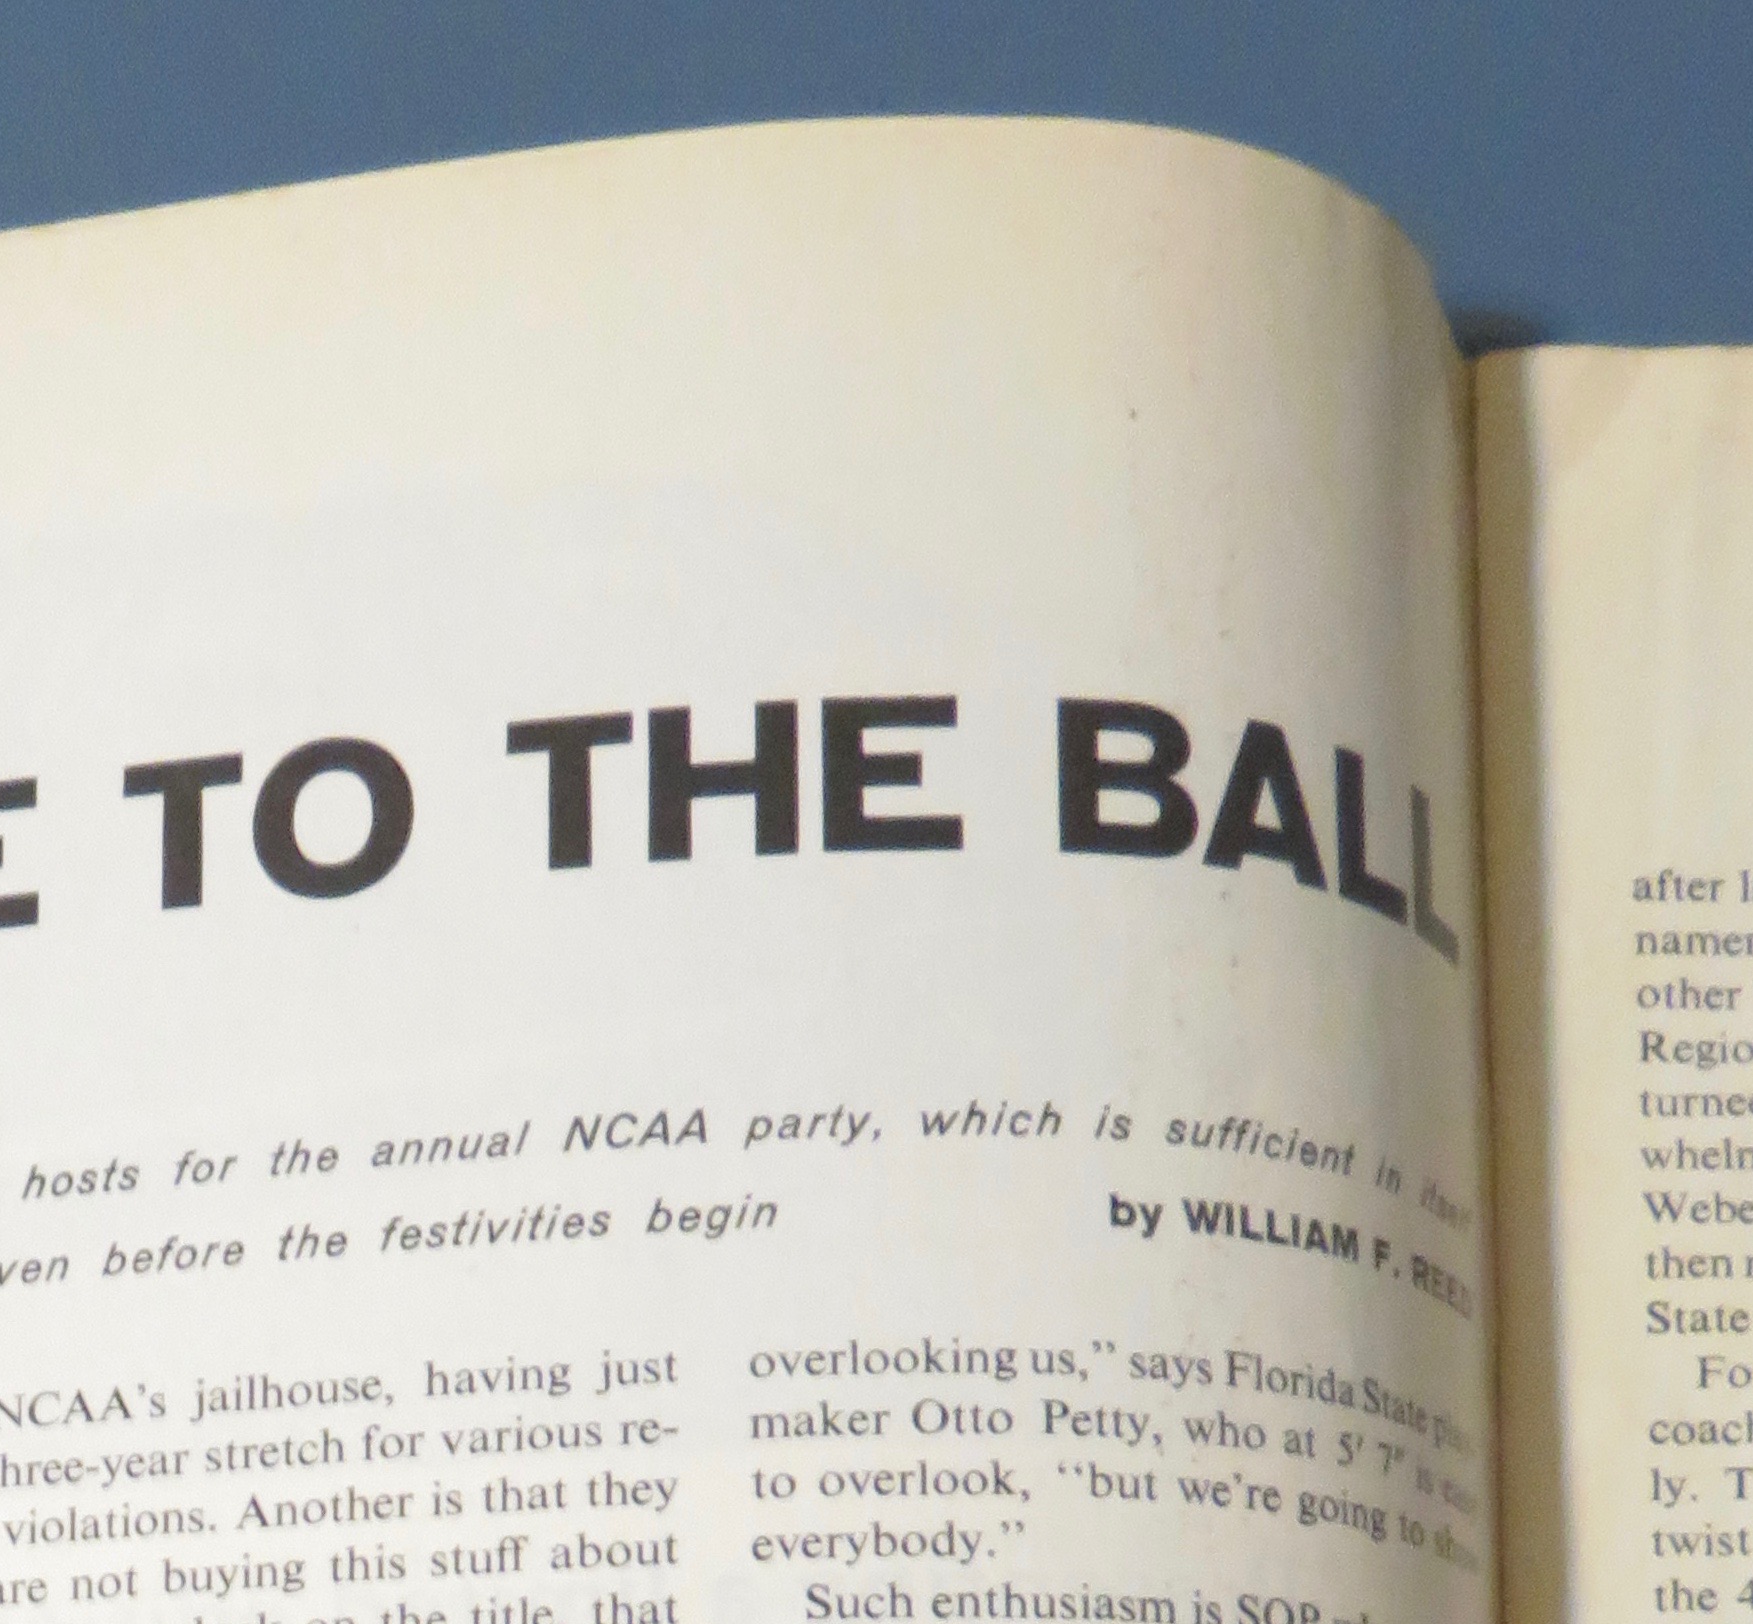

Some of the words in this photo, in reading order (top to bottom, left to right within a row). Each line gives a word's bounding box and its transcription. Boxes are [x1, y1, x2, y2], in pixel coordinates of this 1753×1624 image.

[124, 740, 413, 908] TO
[508, 697, 963, 869] THE
[1058, 699, 1461, 968] BALL
[1633, 868, 1724, 901] after
[1637, 975, 1742, 1010] other
[22, 1159, 139, 1200] hosts
[174, 1150, 237, 1185] for
[270, 1139, 339, 1177] the
[371, 1121, 530, 1167] annual
[563, 1108, 707, 1152] NCAA
[744, 1105, 881, 1150] party,
[921, 1100, 1062, 1137] which
[1095, 1105, 1132, 1141] is
[1165, 1116, 1353, 1177] sufficient
[102, 1236, 244, 1276] before
[278, 1224, 348, 1261] the
[381, 1205, 611, 1251] festivities
[646, 1194, 777, 1240] begin
[1110, 1193, 1163, 1239] by
[1182, 1199, 1359, 1262] WILLIAM
[1373, 1237, 1399, 1278] F.
[1648, 1245, 1734, 1279] then
[1647, 1300, 1751, 1335] State
[749, 1338, 1018, 1382] overlooking
[1129, 1353, 1213, 1390] says
[1225, 1350, 1355, 1409] Florida
[1363, 1376, 1429, 1435] State
[205, 1428, 345, 1472] stretch
[362, 1424, 425, 1462] for
[441, 1415, 603, 1456] various
[751, 1401, 890, 1439] maker
[911, 1399, 1013, 1435] Otto
[1044, 1399, 1162, 1447] Petty,
[1184, 1410, 1266, 1450] who
[1283, 1428, 1316, 1459] at
[753, 1470, 796, 1499] to
[819, 1460, 1030, 1502] overlook,
[1298, 1491, 1388, 1544] going
[72, 1567, 137, 1601] not
[163, 1553, 305, 1599] buying
[330, 1544, 406, 1584] this
[431, 1535, 529, 1577] stuff
[550, 1532, 678, 1571] about
[806, 1582, 914, 1620] Such
[931, 1582, 1176, 1624] enthusiasm
